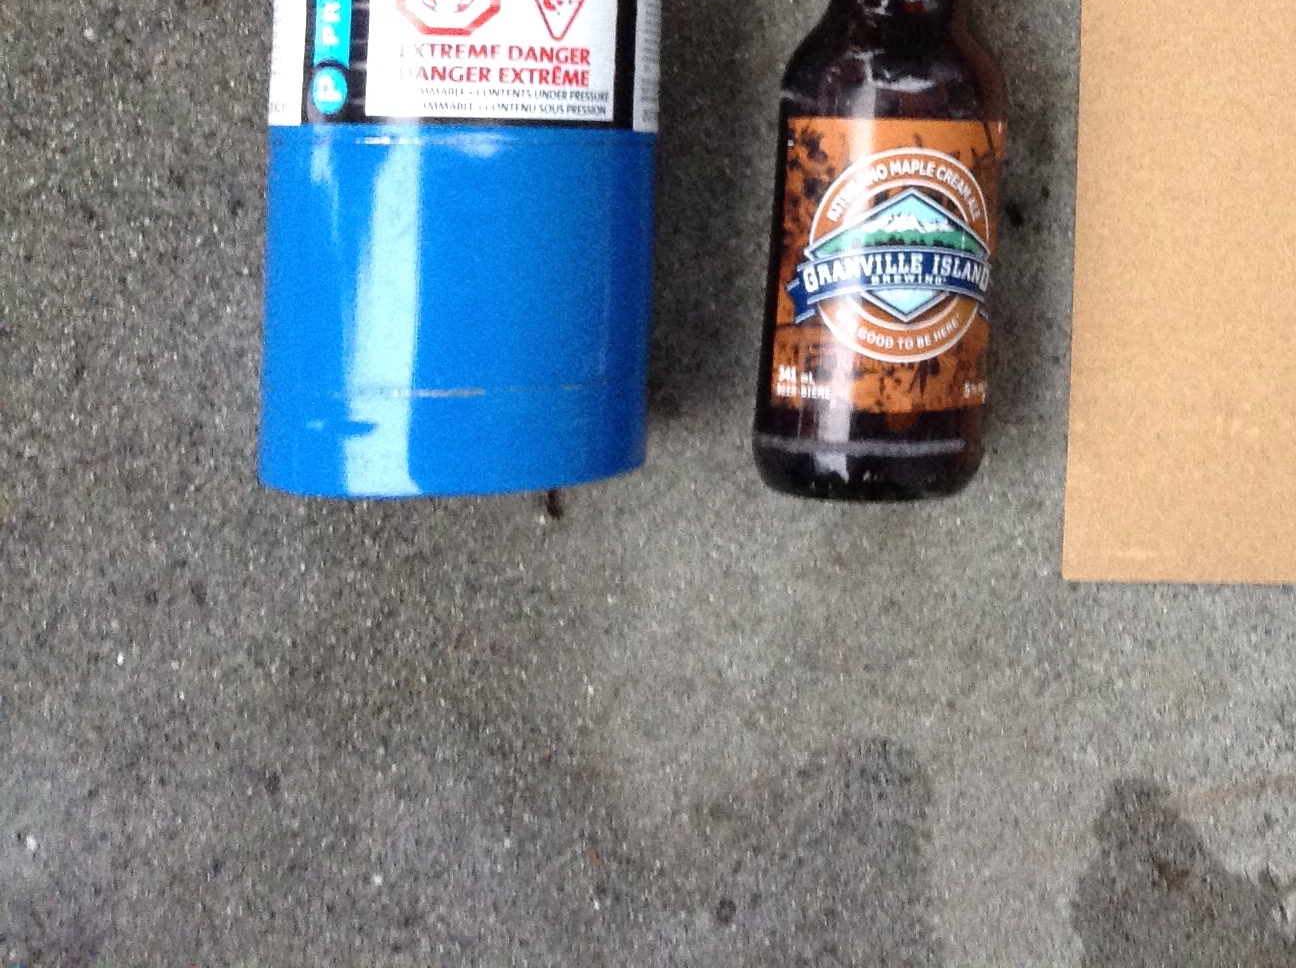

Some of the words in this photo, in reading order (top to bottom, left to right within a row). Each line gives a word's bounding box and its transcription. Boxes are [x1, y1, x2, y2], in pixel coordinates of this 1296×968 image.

[508, 46, 591, 66] DANGER
[317, 74, 343, 102] P
[499, 65, 590, 88] EXTRÊME
[535, 89, 568, 100] UNDER
[569, 90, 610, 102] PRESSURE
[539, 104, 565, 115] SOUS
[566, 104, 607, 116] PRESSION
[889, 159, 935, 178] MAPLE
[936, 165, 970, 201] CREAM
[803, 253, 924, 292] GRANVILLE
[932, 254, 990, 292] ISLAND
[871, 274, 943, 286] BREWING
[857, 326, 894, 349] GOOD
[897, 338, 914, 350] TO
[917, 334, 931, 348] BE
